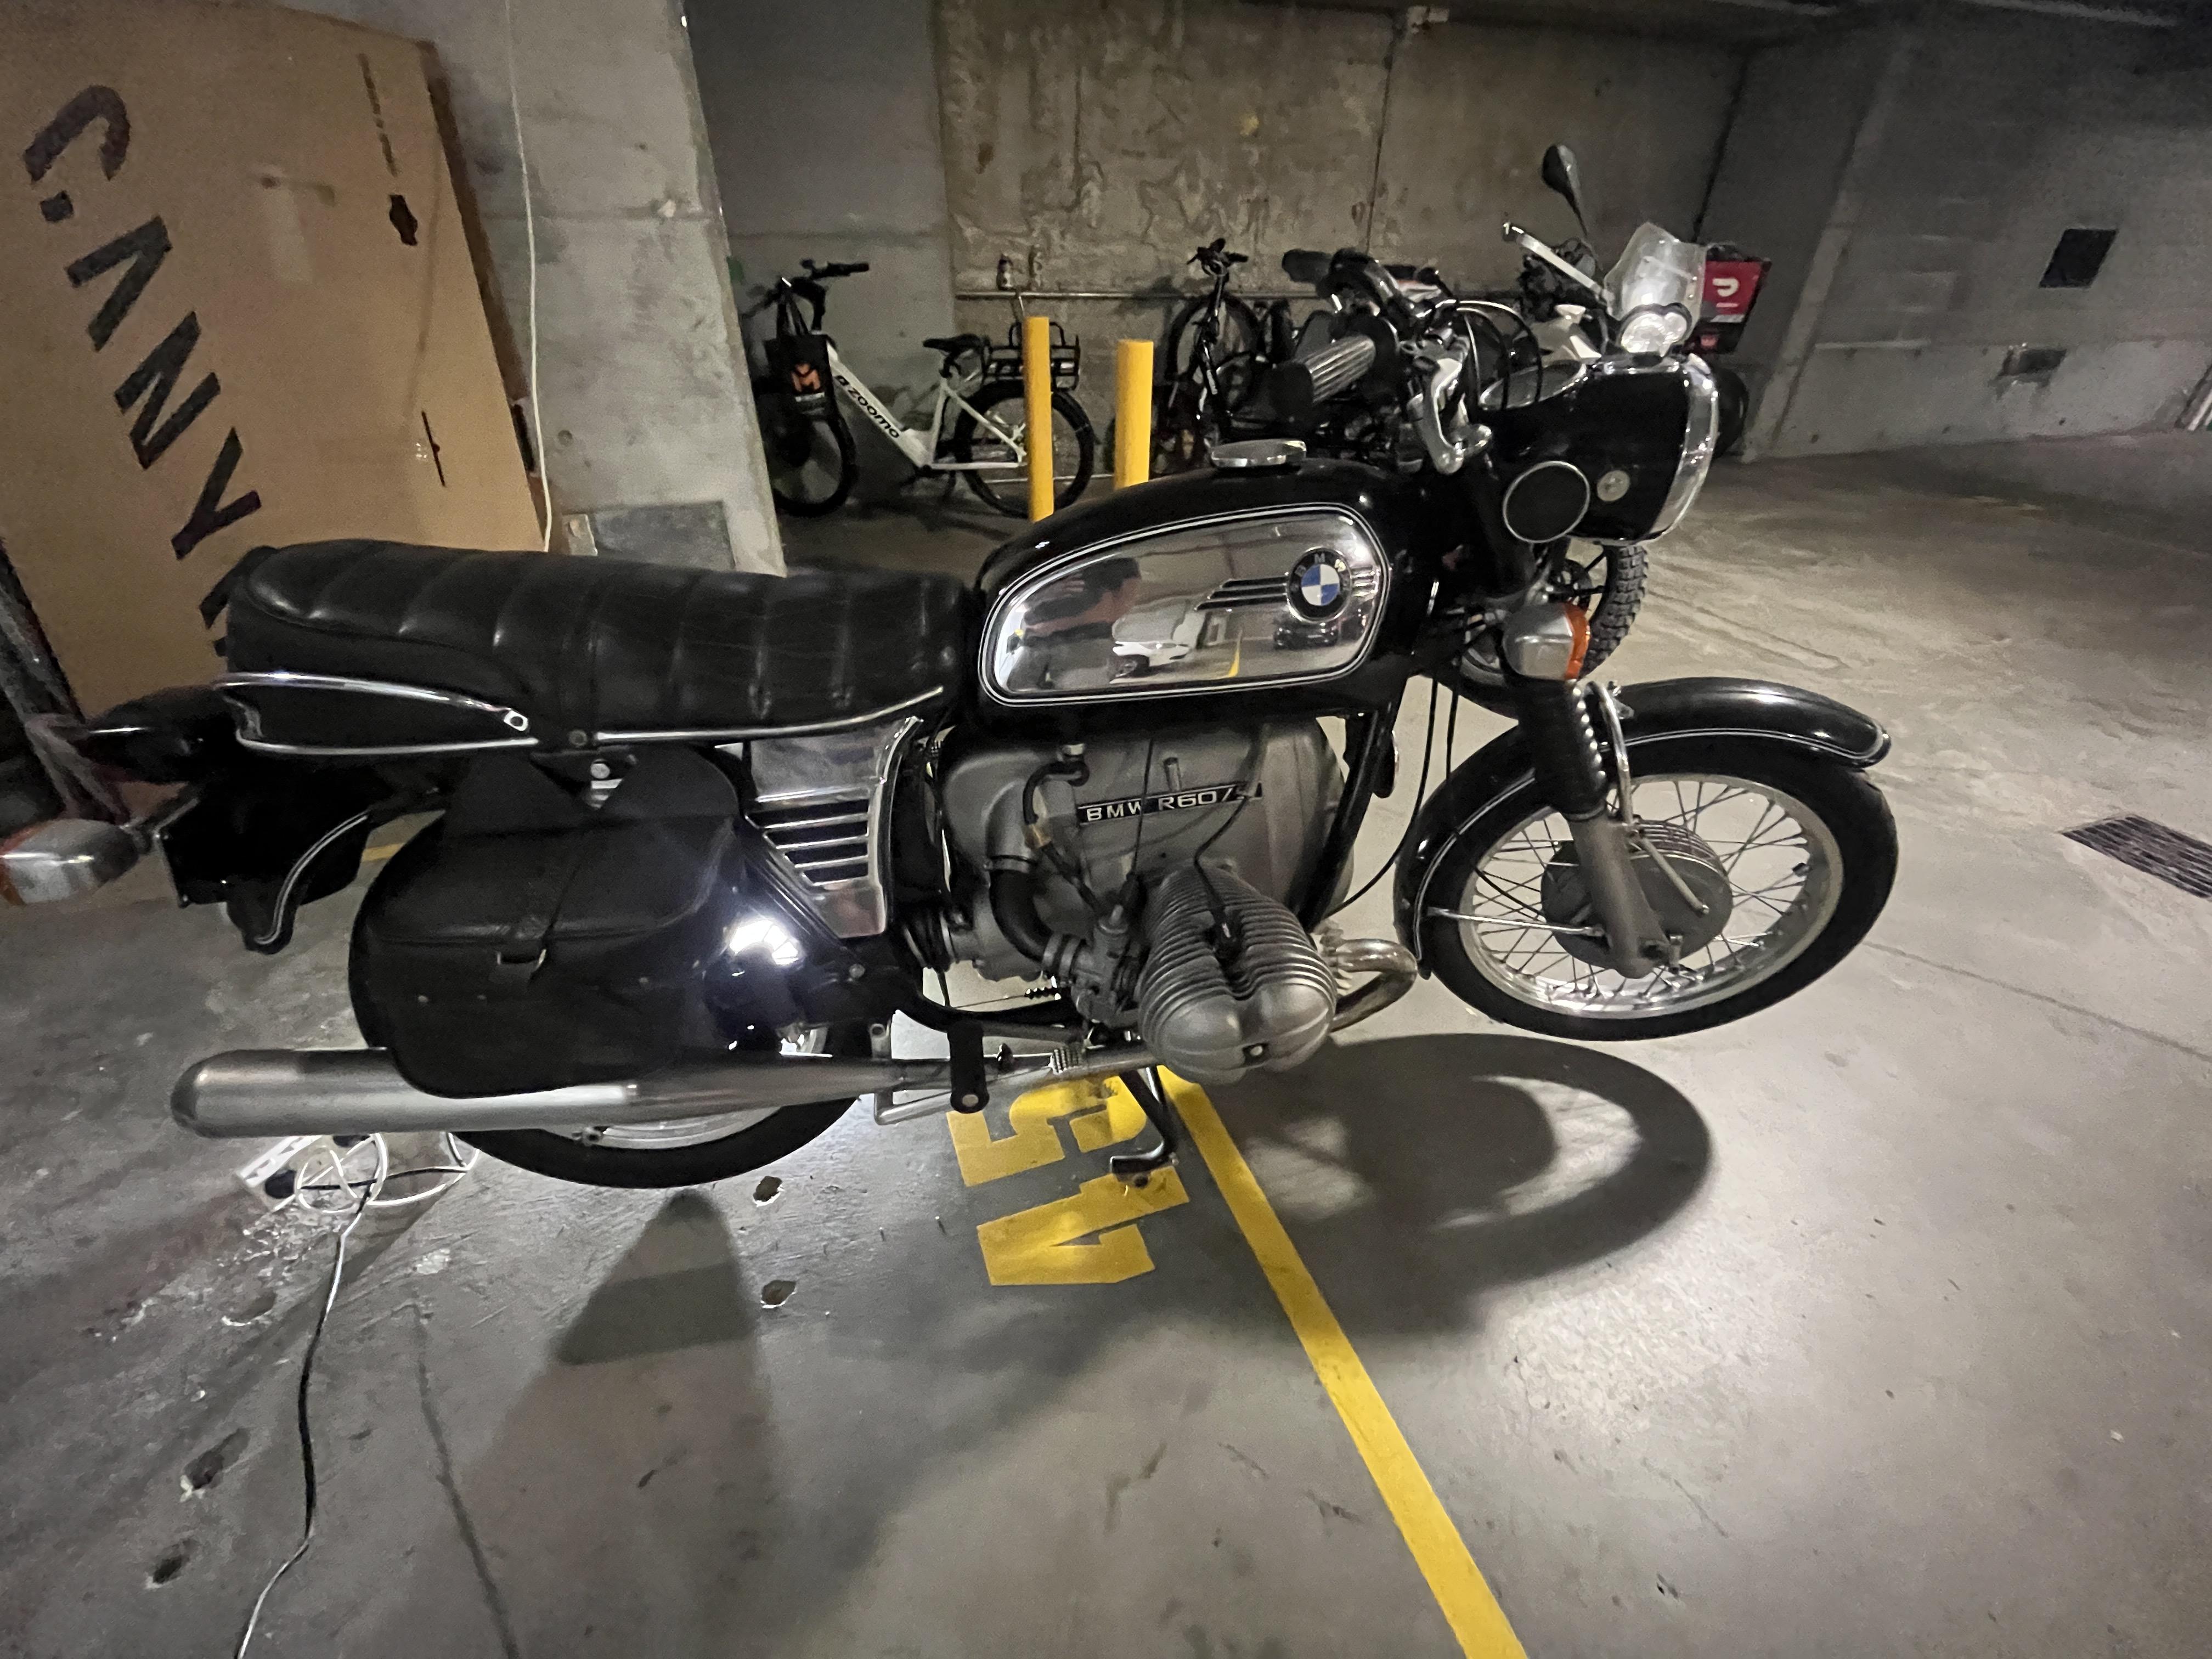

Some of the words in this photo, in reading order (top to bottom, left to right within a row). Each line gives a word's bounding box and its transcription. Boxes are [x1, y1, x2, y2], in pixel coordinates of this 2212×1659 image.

[848, 387, 900, 439] zoomo
[1086, 800, 1143, 822] BMW
[1158, 787, 1245, 811] R60/
[946, 1074, 1190, 1286] 45
